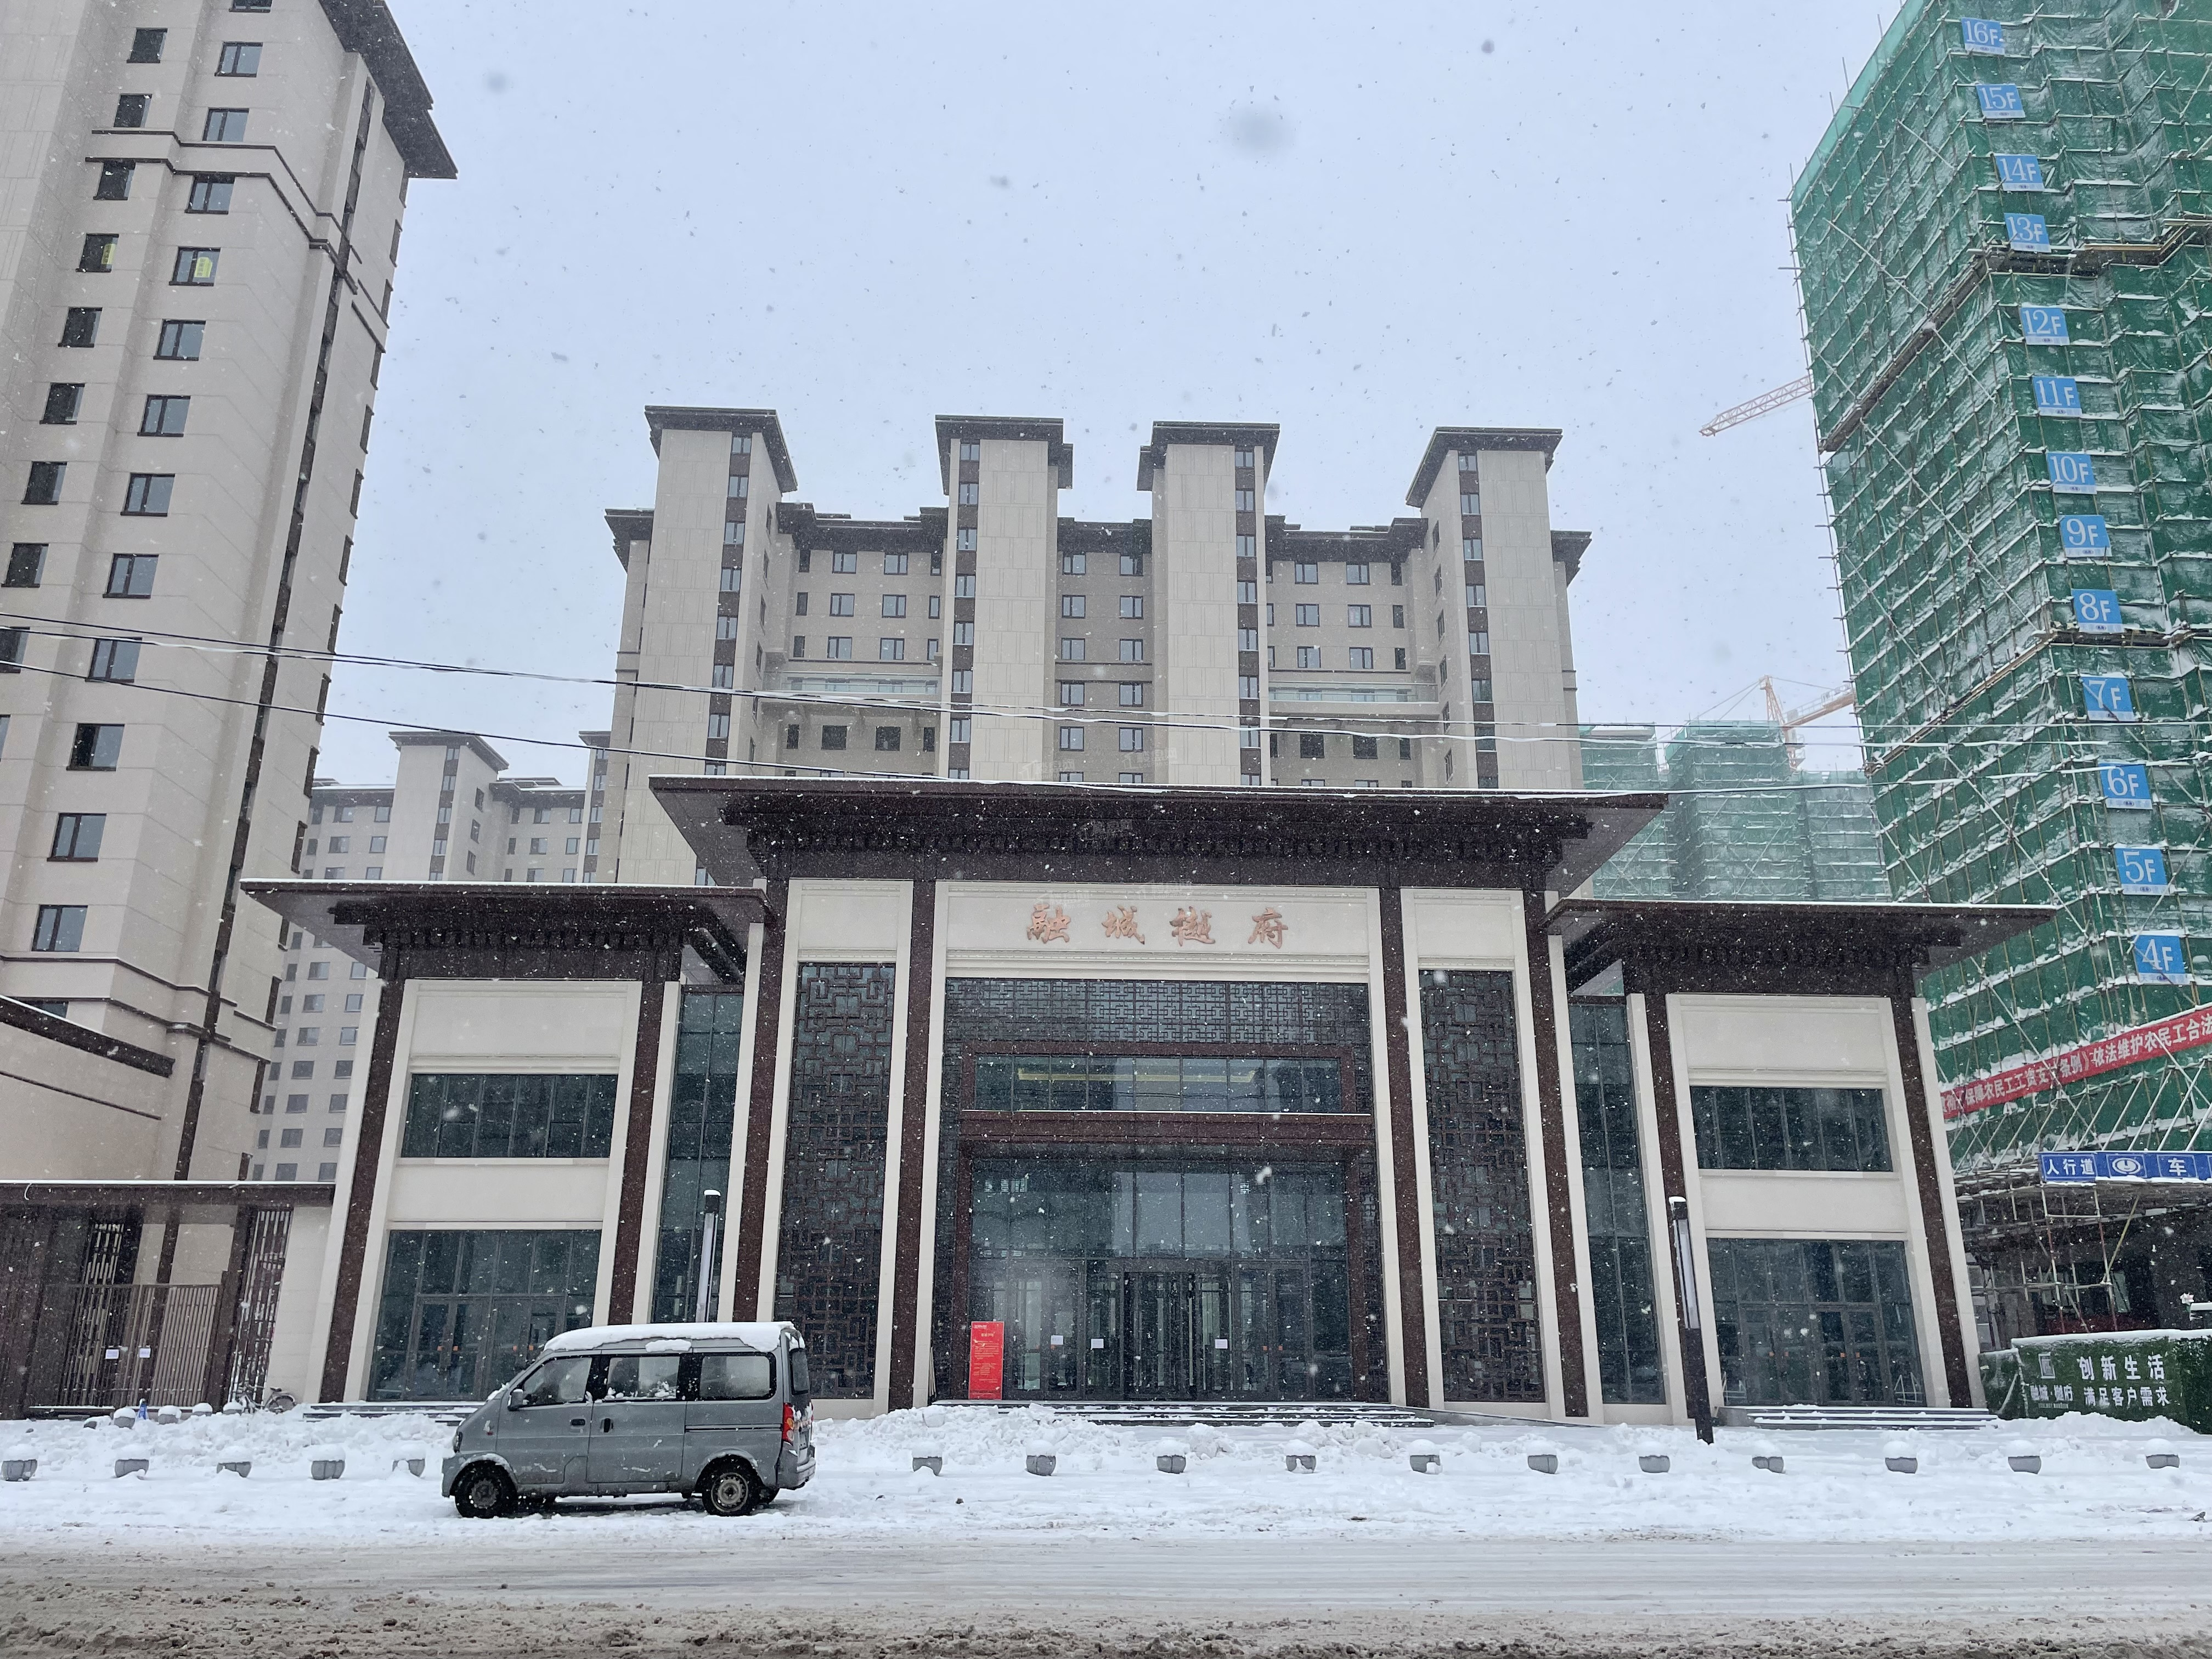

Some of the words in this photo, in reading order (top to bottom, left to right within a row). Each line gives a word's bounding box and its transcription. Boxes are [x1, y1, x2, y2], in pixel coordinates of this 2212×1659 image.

[1963, 20, 1999, 46] 16F
[1981, 87, 2017, 109] 15F
[2000, 157, 2037, 182] 14F
[2007, 217, 2043, 242] 13F
[2023, 309, 2061, 336] 12F
[2035, 380, 2074, 407] 11F
[2049, 456, 2089, 483] 10F
[2067, 518, 2099, 546] 9F
[2078, 594, 2111, 622] 8F
[2088, 680, 2121, 709] 7F
[2107, 766, 2138, 796] 6F
[2124, 851, 2156, 882] 5F
[2142, 939, 2173, 971] 4F
[2047, 1158, 2095, 1175] 人行道
[2168, 1158, 2187, 1176] 车
[2076, 1353, 2165, 1380] 创新生活
[2084, 1386, 2170, 1407] 满足客户需求
